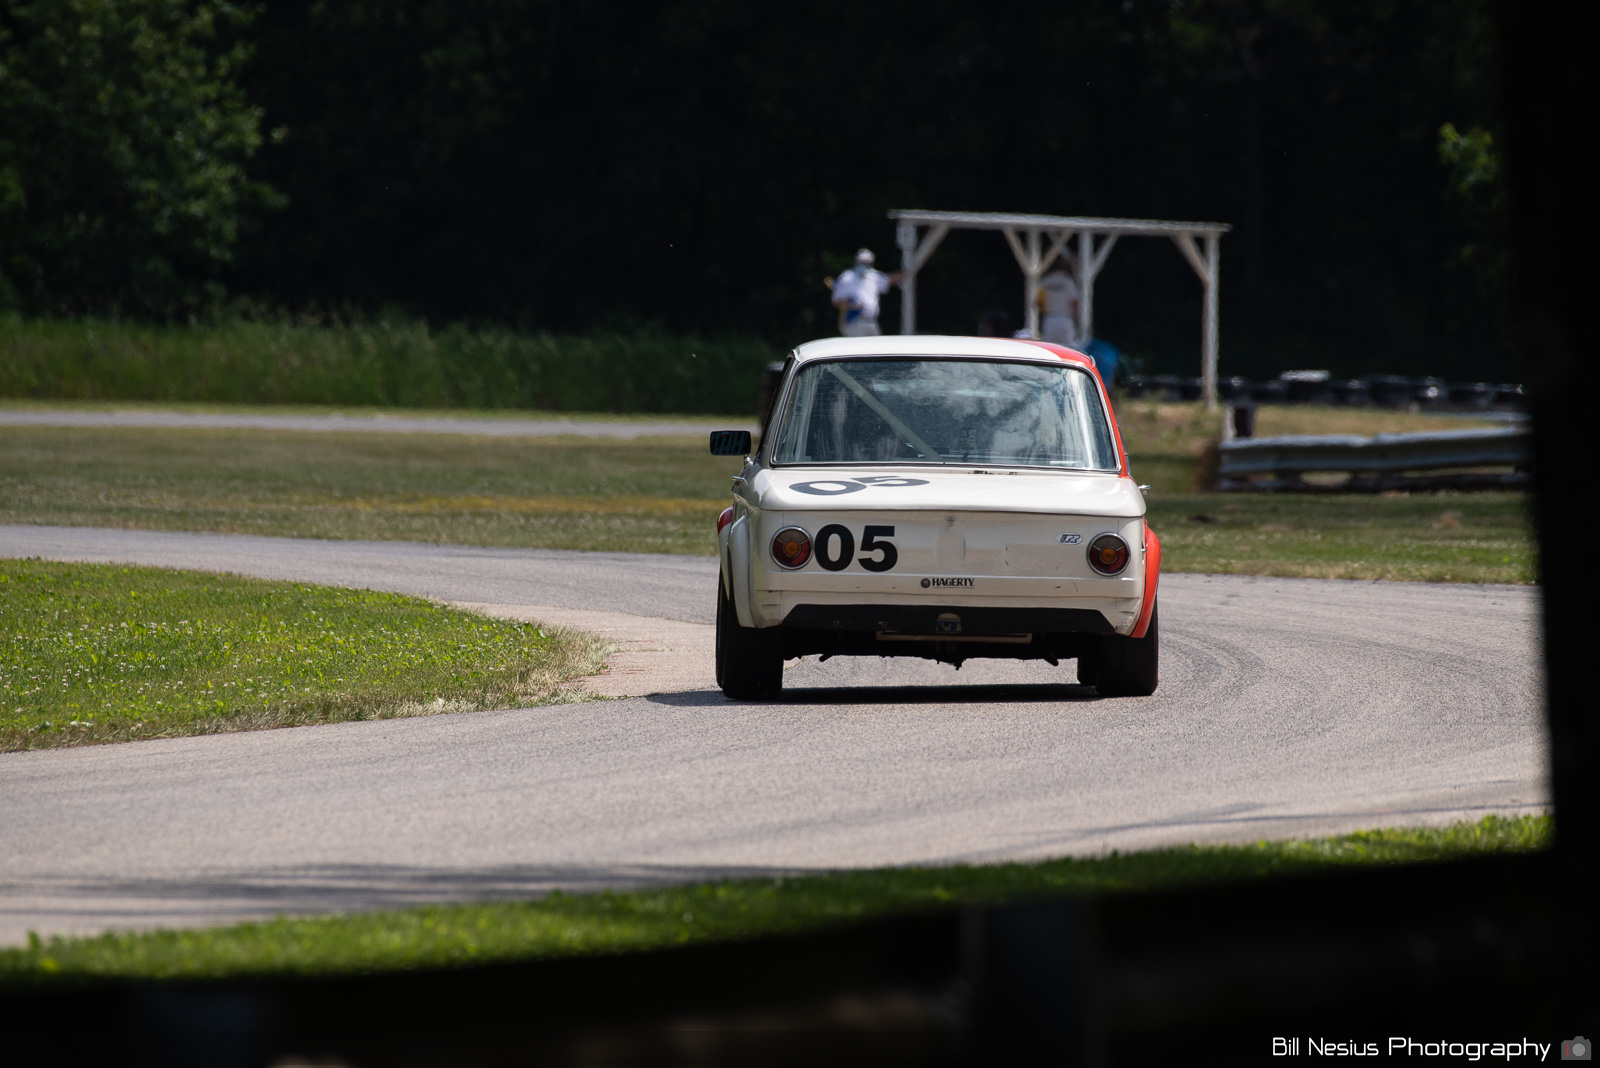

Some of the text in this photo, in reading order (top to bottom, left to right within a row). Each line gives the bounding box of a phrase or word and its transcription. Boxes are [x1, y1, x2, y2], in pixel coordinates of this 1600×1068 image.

[789, 475, 930, 496] 05
[814, 523, 899, 573] 05
[932, 577, 975, 587] HAGERTY
